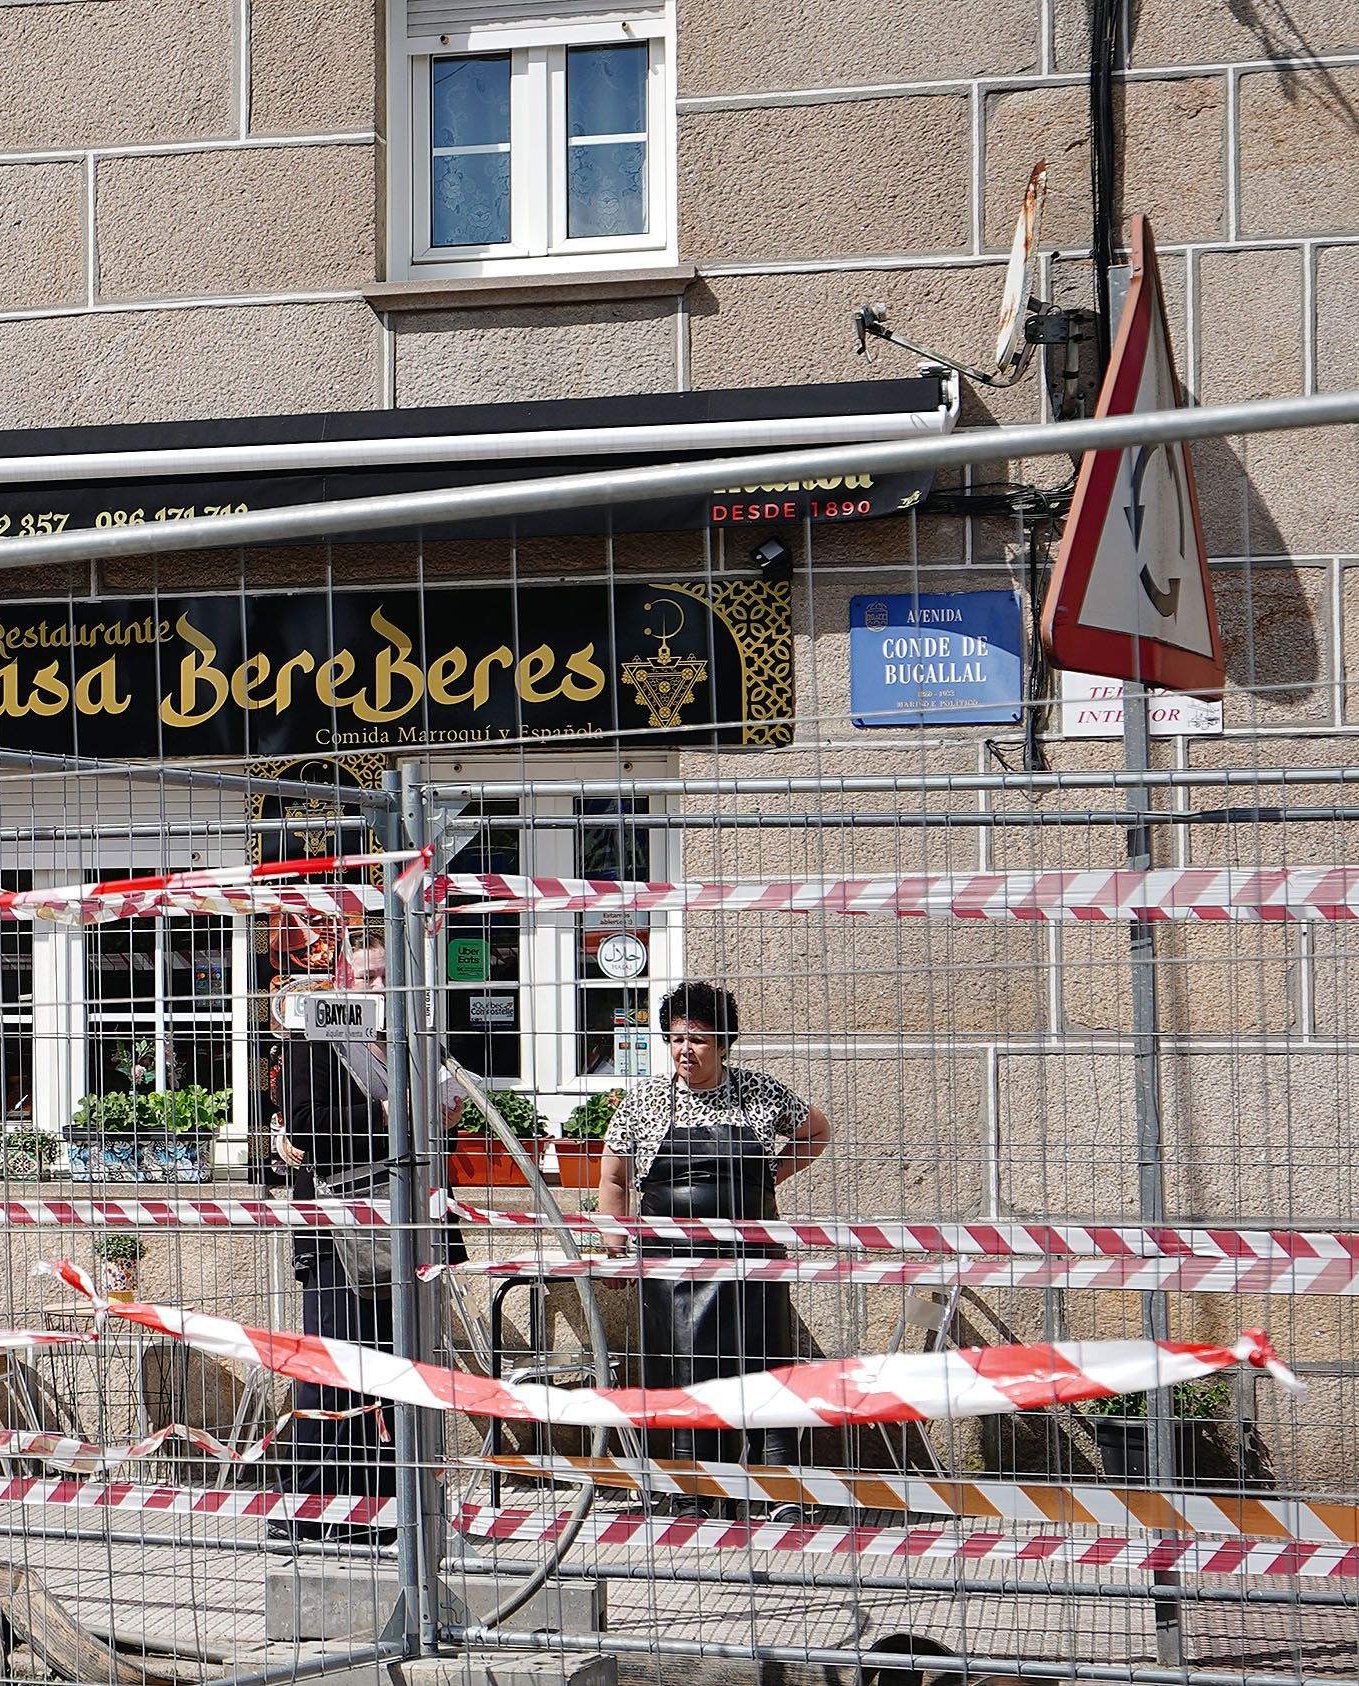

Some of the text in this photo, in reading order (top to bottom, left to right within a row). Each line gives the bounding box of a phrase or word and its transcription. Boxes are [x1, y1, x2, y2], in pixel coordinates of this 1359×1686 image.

[712, 500, 872, 521] DESDE 1890
[18, 511, 71, 538] 357
[907, 608, 963, 624] AVENIDA
[882, 635, 989, 659] CONDE DE
[159, 604, 606, 728] BereBeres
[885, 662, 987, 685] BUGALLAL
[1077, 708, 1180, 724] INTEOR
[315, 726, 389, 745] Comida
[398, 725, 490, 744] Marroquí
[499, 729, 511, 742] y
[458, 946, 479, 955] Uber
[458, 955, 480, 964] Eats
